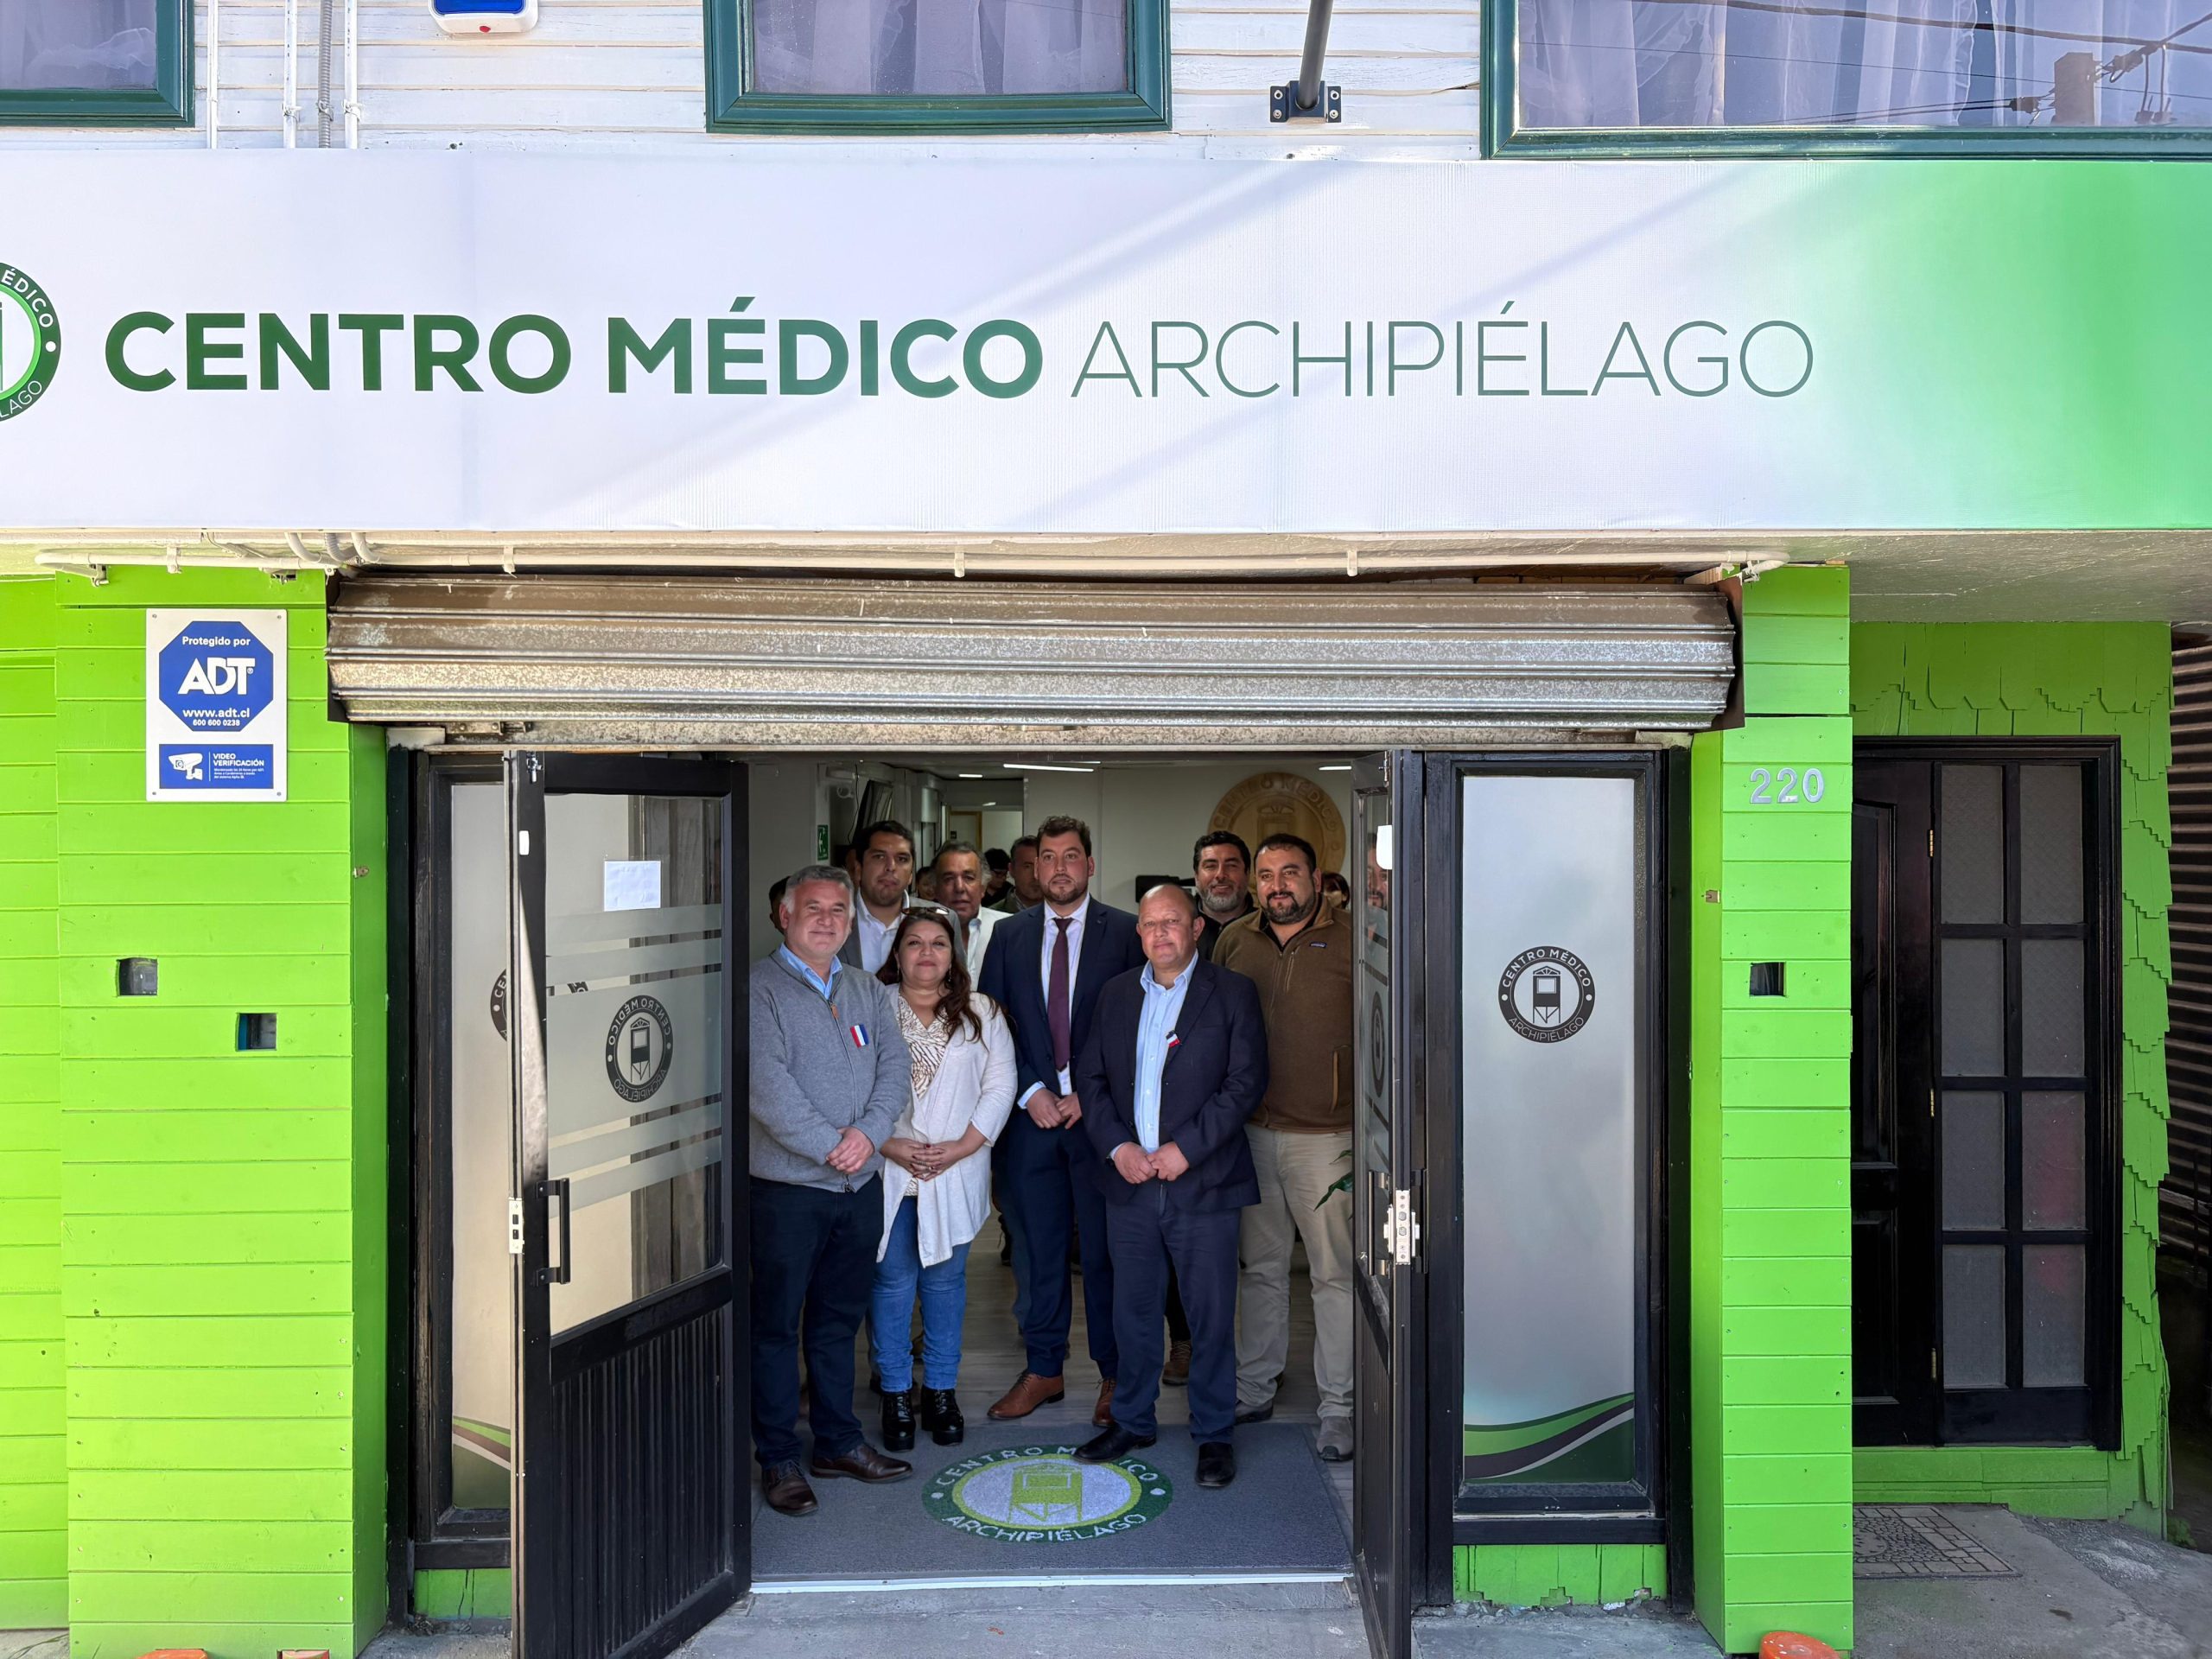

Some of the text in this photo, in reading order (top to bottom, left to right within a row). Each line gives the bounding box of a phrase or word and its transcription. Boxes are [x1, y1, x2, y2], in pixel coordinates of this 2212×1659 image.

[0, 268, 54, 327] ÉDICO
[105, 296, 1813, 398] CENTRO MÉDICO ARCHIPIÉLAGO
[182, 636, 251, 647] Protegido por
[177, 657, 256, 695] ADT
[182, 707, 250, 718] www.adt.cl
[213, 758, 264, 766] VERIFICACIÓN
[1750, 767, 1824, 804] 220
[1503, 949, 1591, 988] CENTRO MÉDICO
[1509, 1017, 1584, 1041] ARCHIPIÉLAGO
[936, 1446, 1158, 1485] CENTRO MICO
[942, 1513, 1147, 1542] ARCHIPIÉLAGO
